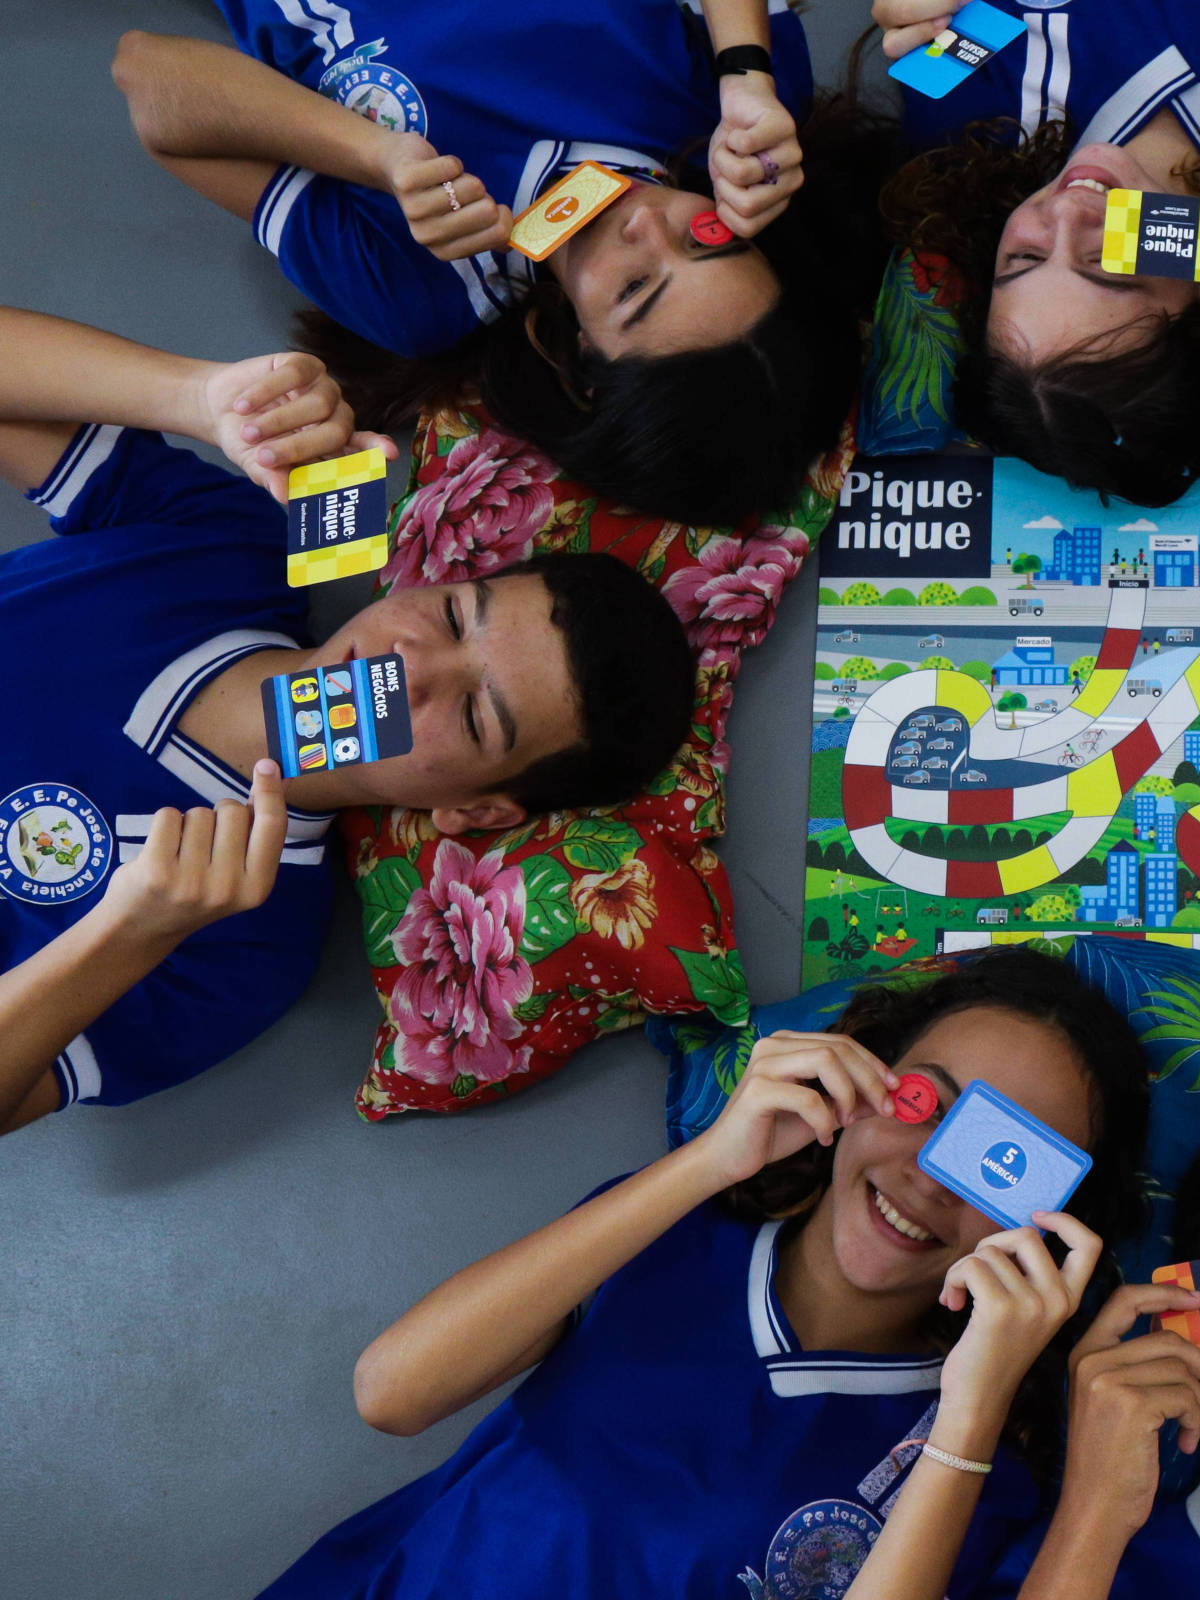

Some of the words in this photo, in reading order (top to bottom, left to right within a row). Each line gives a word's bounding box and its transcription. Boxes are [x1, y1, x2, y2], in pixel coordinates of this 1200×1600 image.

[957, 49, 979, 64] CARTA
[958, 39, 989, 58] DESAFIO
[1145, 224, 1195, 241] nique
[322, 493, 342, 540] nique
[838, 512, 971, 558] nique
[384, 661, 399, 692] BONS
[370, 663, 388, 719] NEGÓCIOS
[10, 798, 30, 812] E.
[33, 789, 51, 803] E.
[56, 790, 78, 807] Pe
[79, 808, 106, 843] José
[90, 847, 105, 867] de
[21, 868, 94, 898] Anchieta
[912, 1091, 922, 1101] 2
[1002, 1147, 1018, 1164] 5
[981, 1157, 1018, 1185] AMÉRICAS
